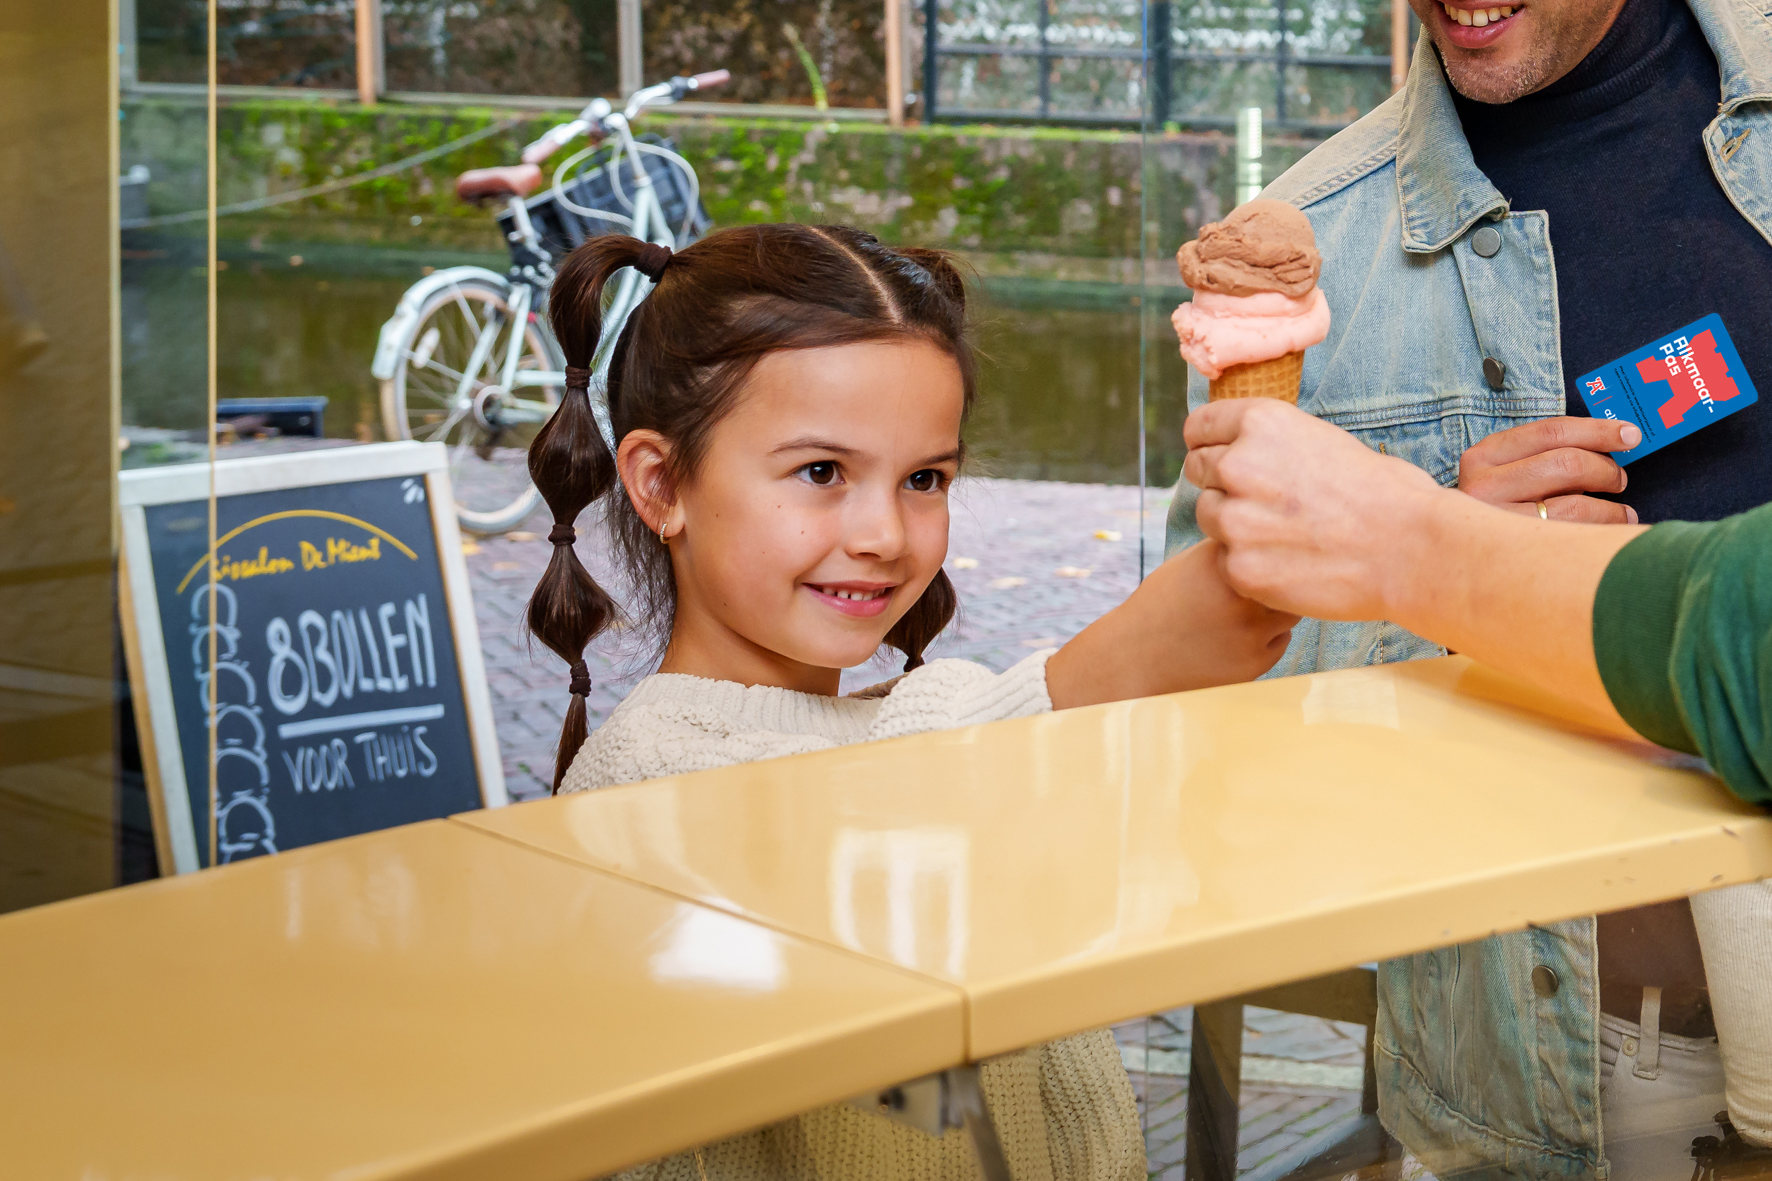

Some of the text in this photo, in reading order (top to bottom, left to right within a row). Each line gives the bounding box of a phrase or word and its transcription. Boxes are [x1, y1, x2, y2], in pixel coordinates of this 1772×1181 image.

[1659, 343, 1682, 377] Pas
[1673, 336, 1714, 414] Alkmaar-
[299, 540, 327, 571] De
[282, 736, 355, 794] VOOR
